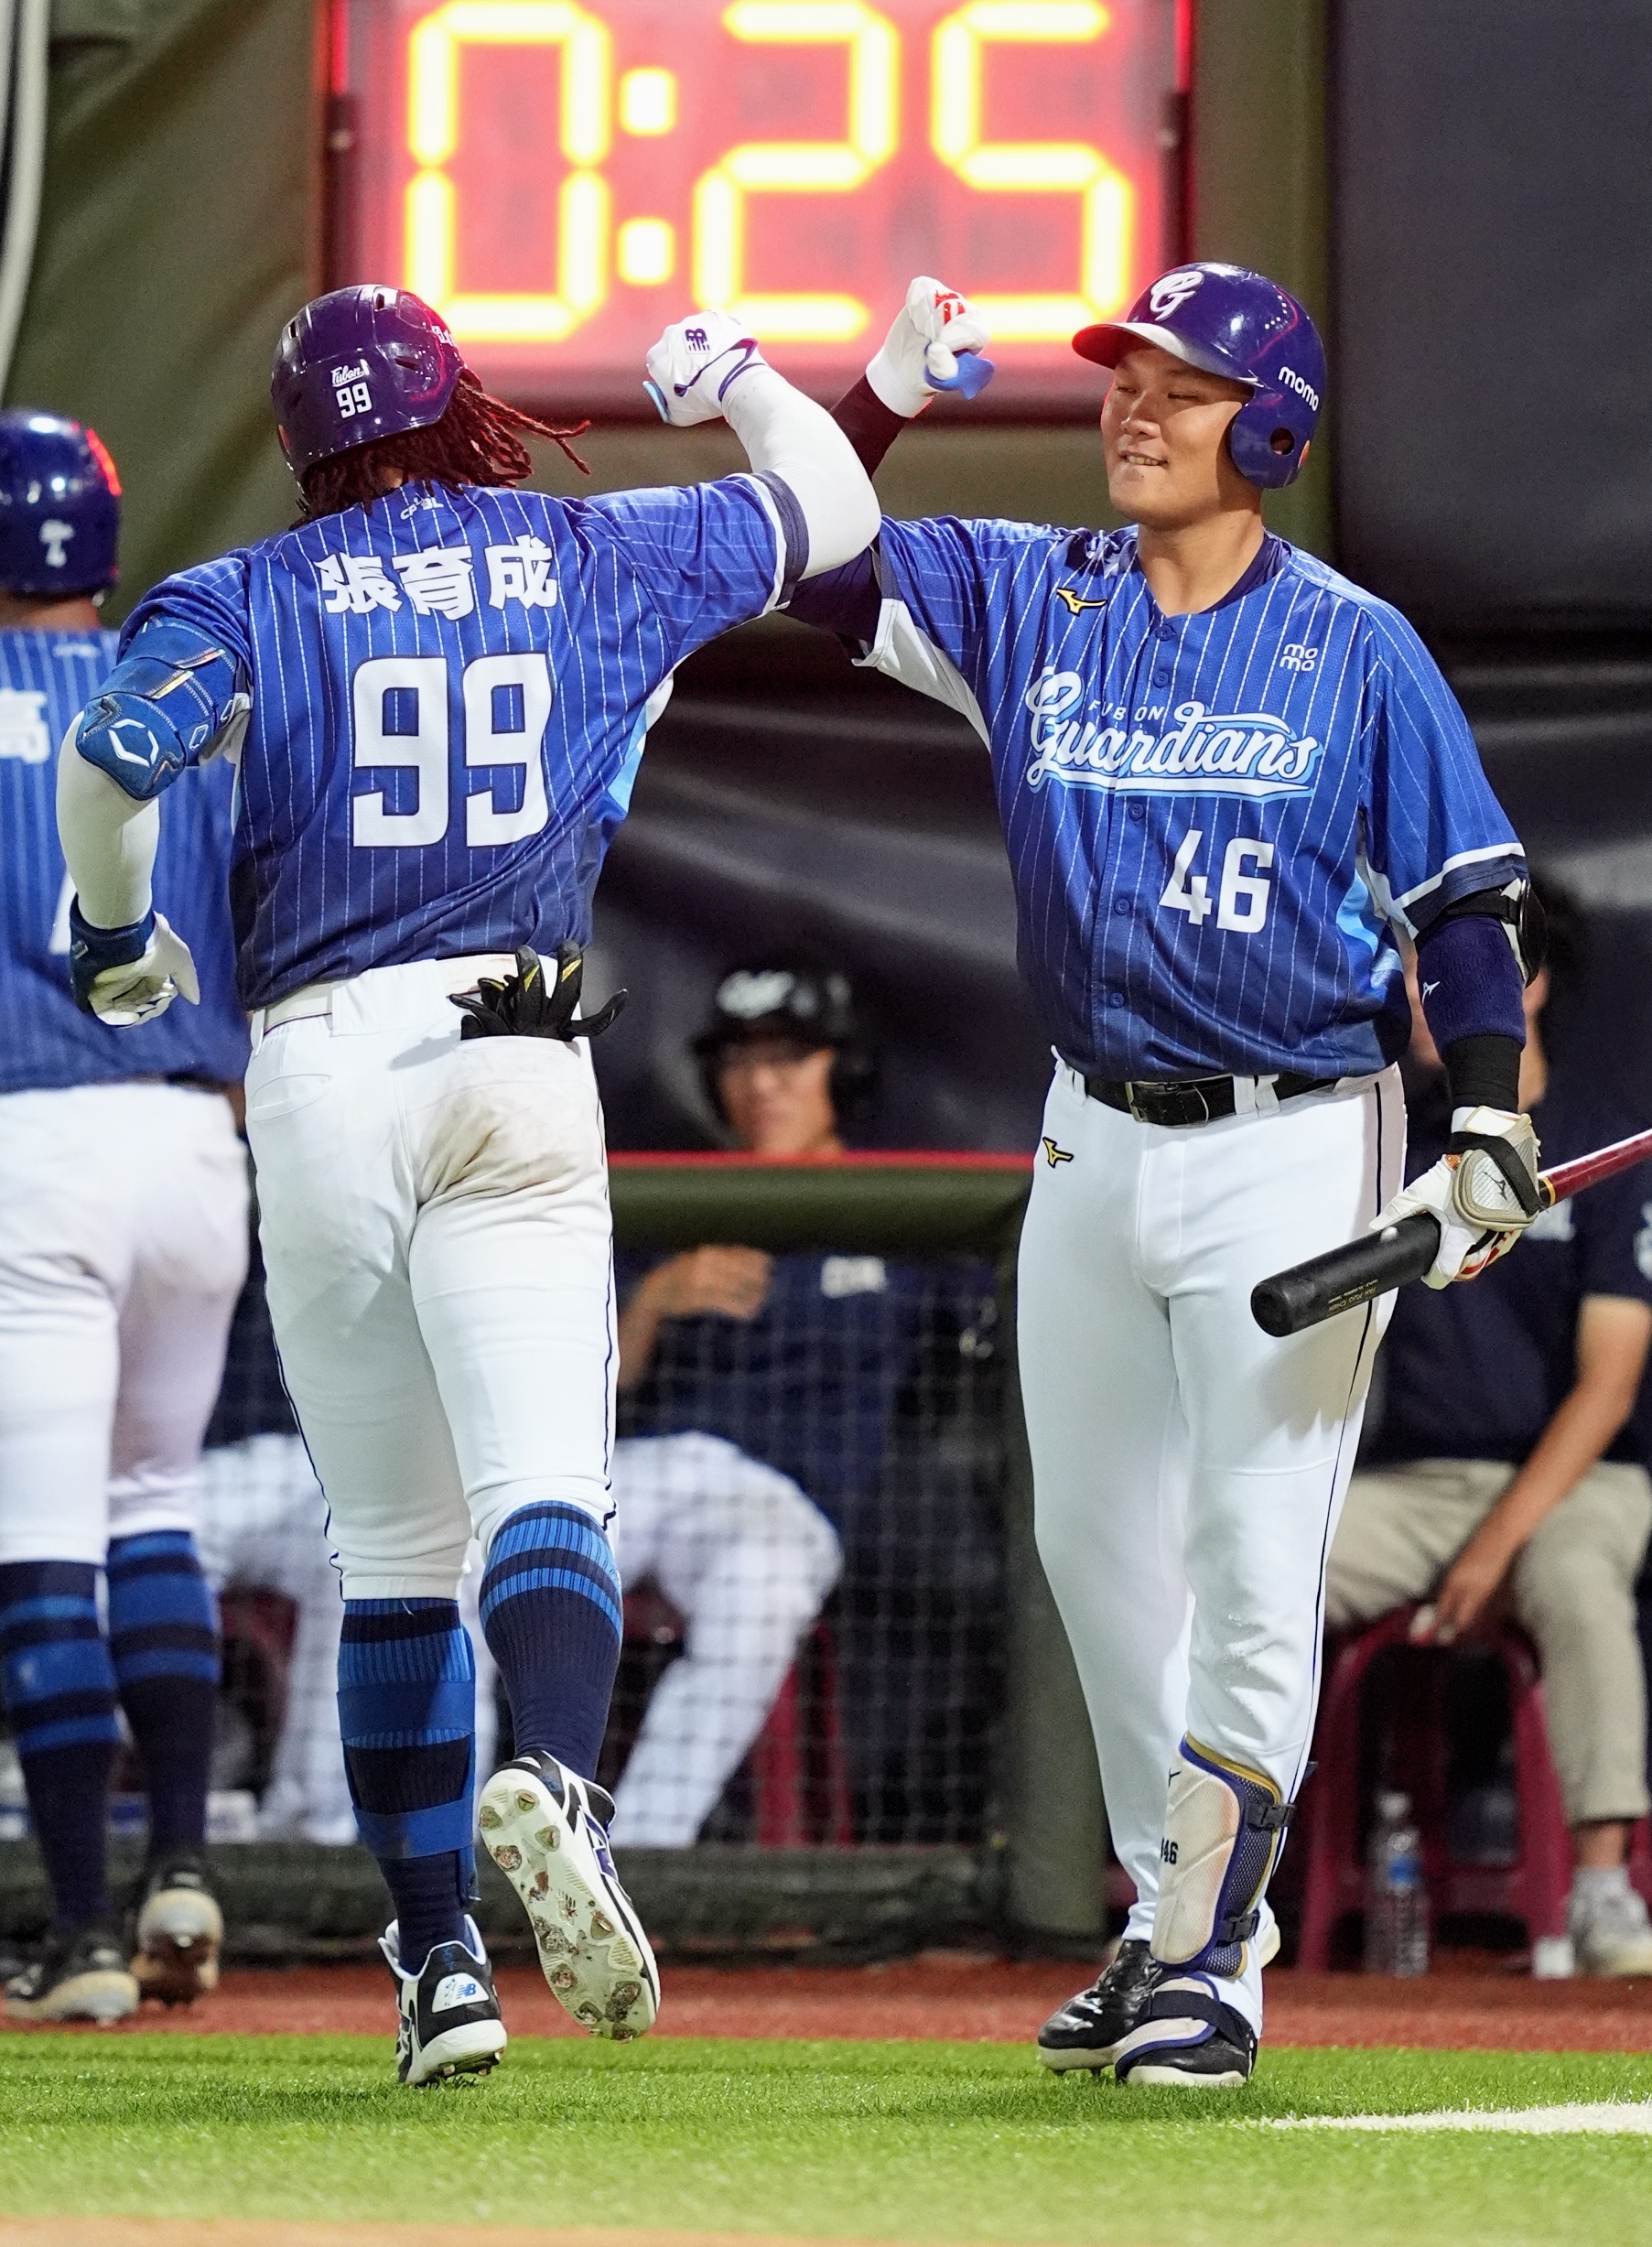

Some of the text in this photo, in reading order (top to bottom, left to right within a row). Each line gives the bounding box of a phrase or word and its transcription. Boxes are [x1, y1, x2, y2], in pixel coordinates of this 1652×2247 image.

[405, 0, 1132, 344] 0:25
[330, 359, 371, 388] Fubon
[335, 383, 373, 419] 99
[1278, 366, 1320, 412] momo
[314, 535, 558, 621] 張育成
[353, 654, 552, 847] 99
[1025, 666, 1323, 794] Guardians
[1159, 829, 1275, 934] 46
